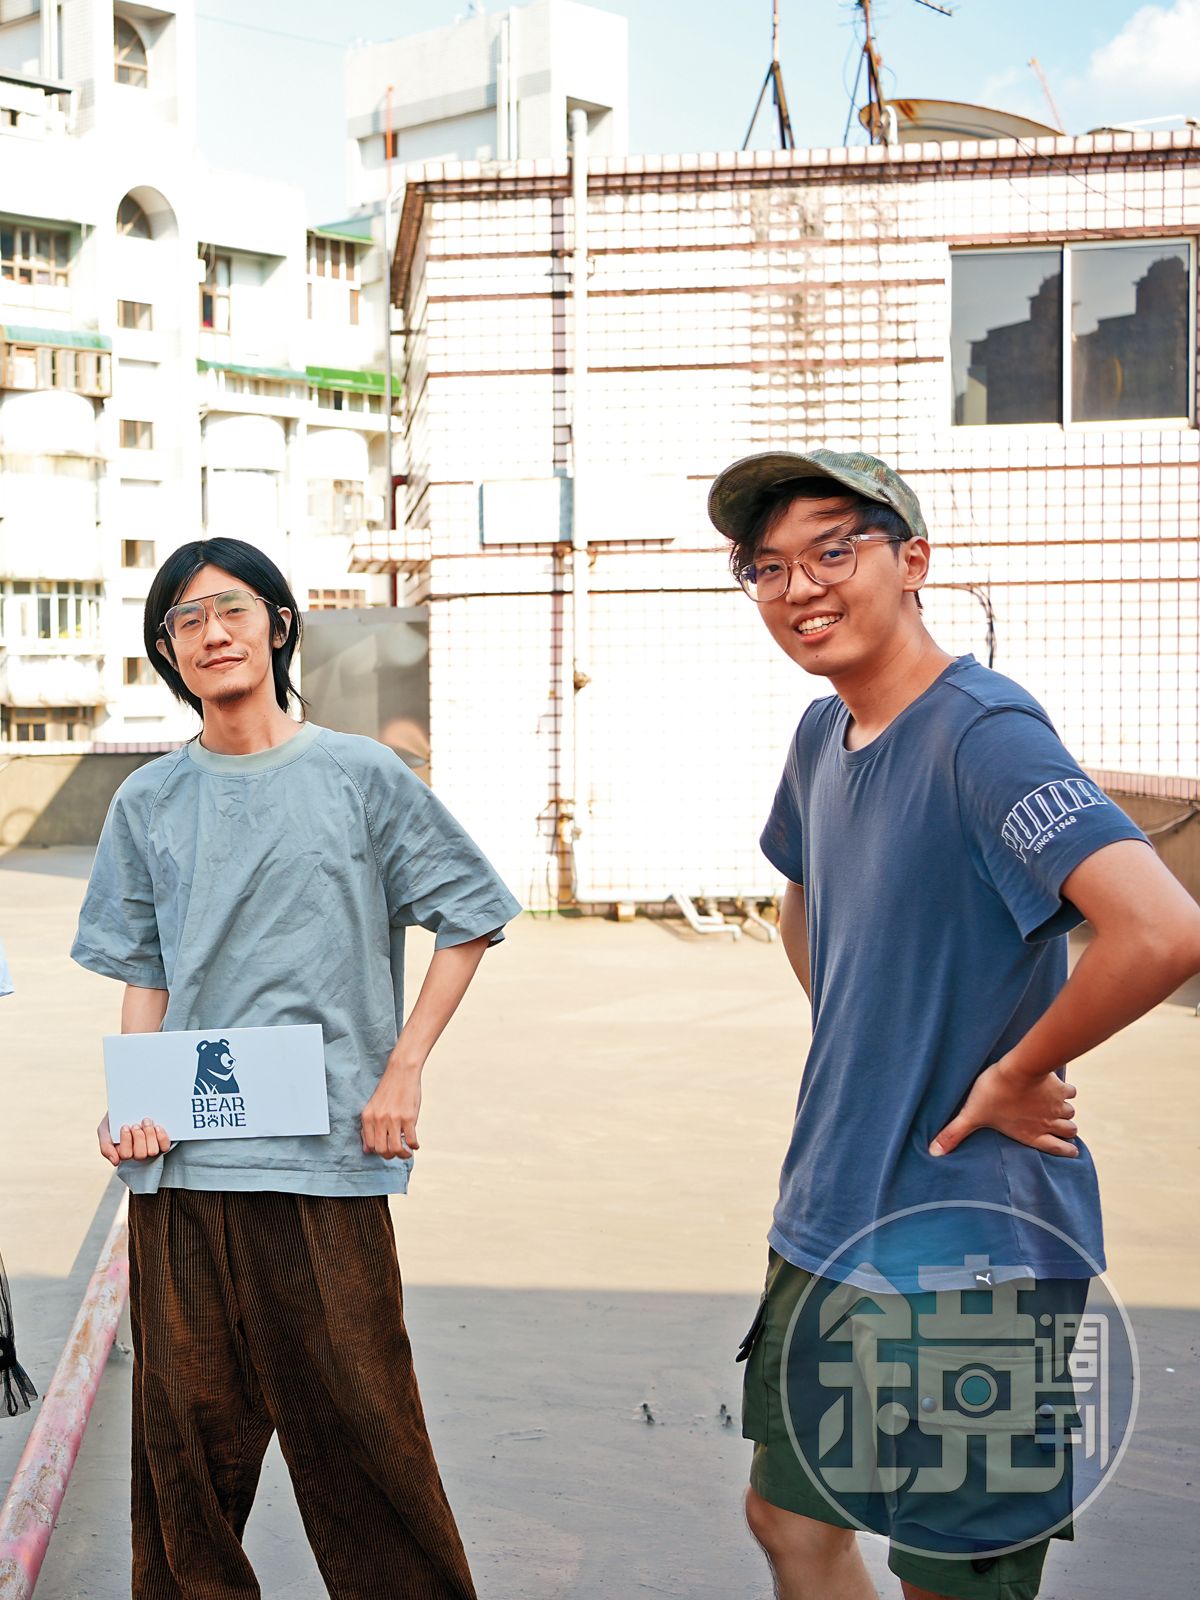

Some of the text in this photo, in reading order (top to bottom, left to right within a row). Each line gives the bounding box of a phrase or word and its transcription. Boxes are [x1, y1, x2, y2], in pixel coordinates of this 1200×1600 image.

[1001, 778, 1108, 864] PUMA
[1033, 815, 1077, 854] SINCE 1948
[191, 1096, 246, 1113] BEAR
[193, 1112, 247, 1129] BONE
